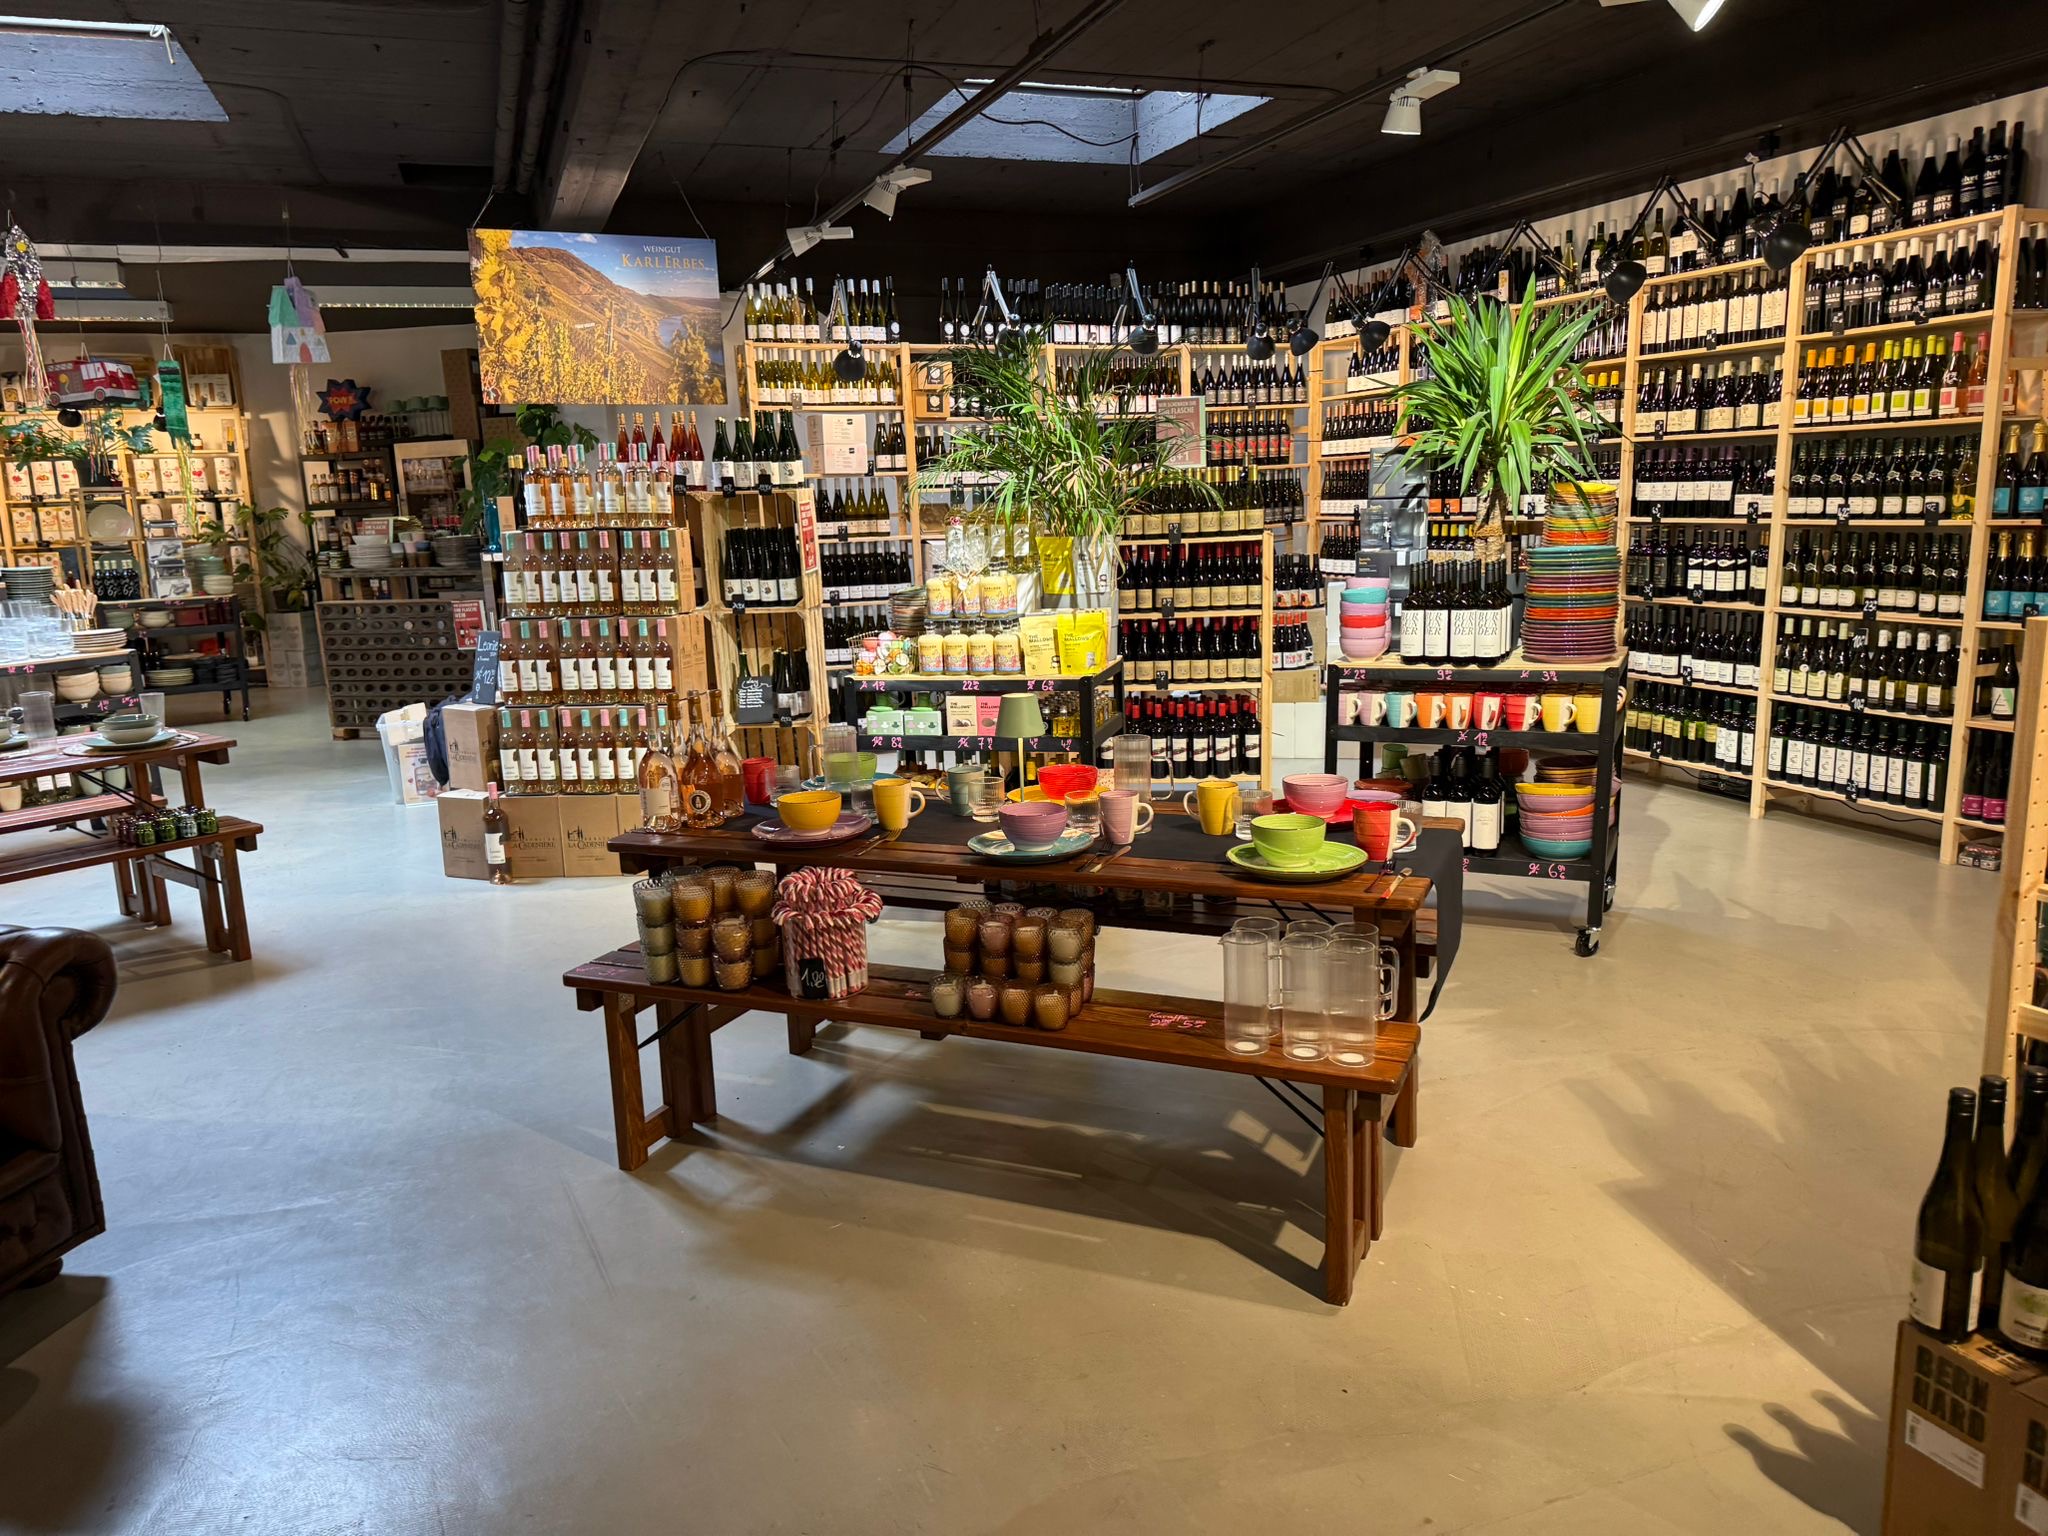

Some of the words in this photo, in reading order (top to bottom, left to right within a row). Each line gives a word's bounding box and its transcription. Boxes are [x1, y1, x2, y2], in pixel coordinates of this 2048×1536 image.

[643, 245, 681, 253] WEINGUT
[1454, 612, 1475, 620] BUR
[1479, 612, 1499, 620] BUR
[1478, 619, 1499, 628] GUN
[1453, 627, 1474, 636] DER
[1478, 627, 1498, 636] DER
[1917, 1345, 1989, 1412] BERN
[1912, 1375, 1985, 1442] HARD
